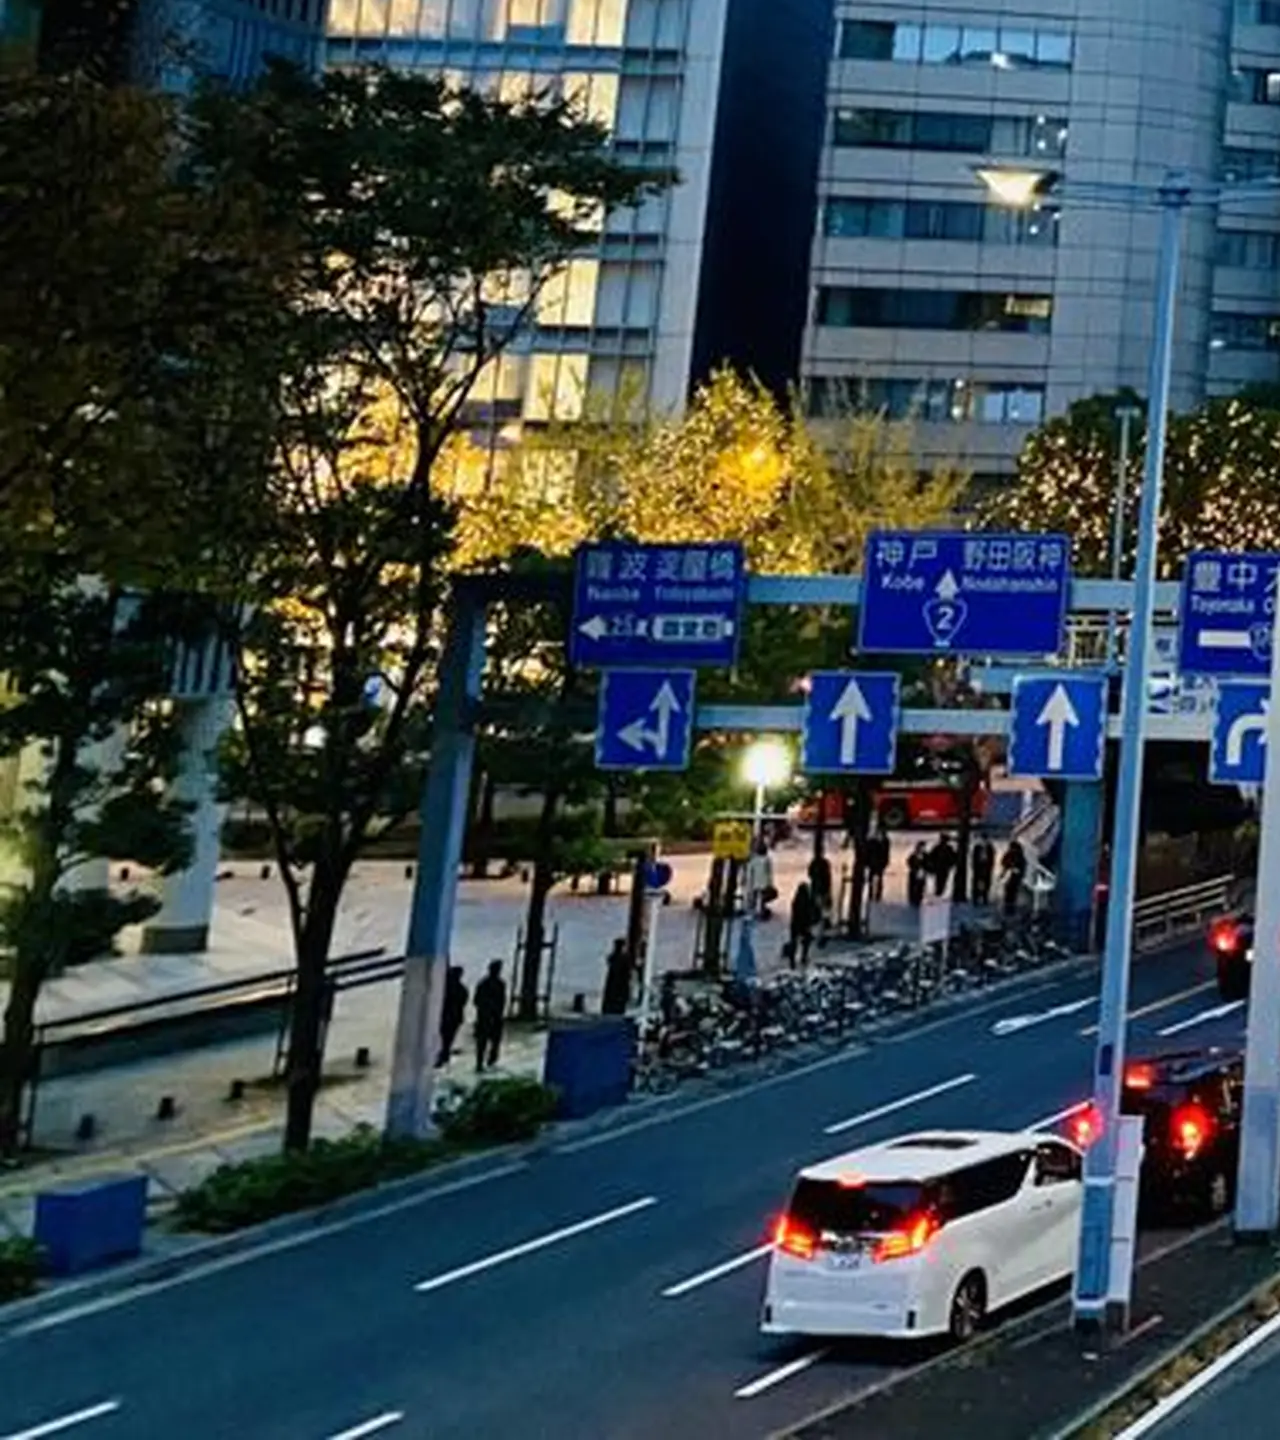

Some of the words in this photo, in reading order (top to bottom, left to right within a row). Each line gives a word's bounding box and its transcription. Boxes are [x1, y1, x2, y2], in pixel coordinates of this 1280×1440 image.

[876, 540, 938, 570] 神戸
[964, 540, 1062, 572] 野田阪神
[881, 573, 925, 591] Kobe
[1191, 561, 1259, 593] 豊中
[935, 606, 955, 631] 2
